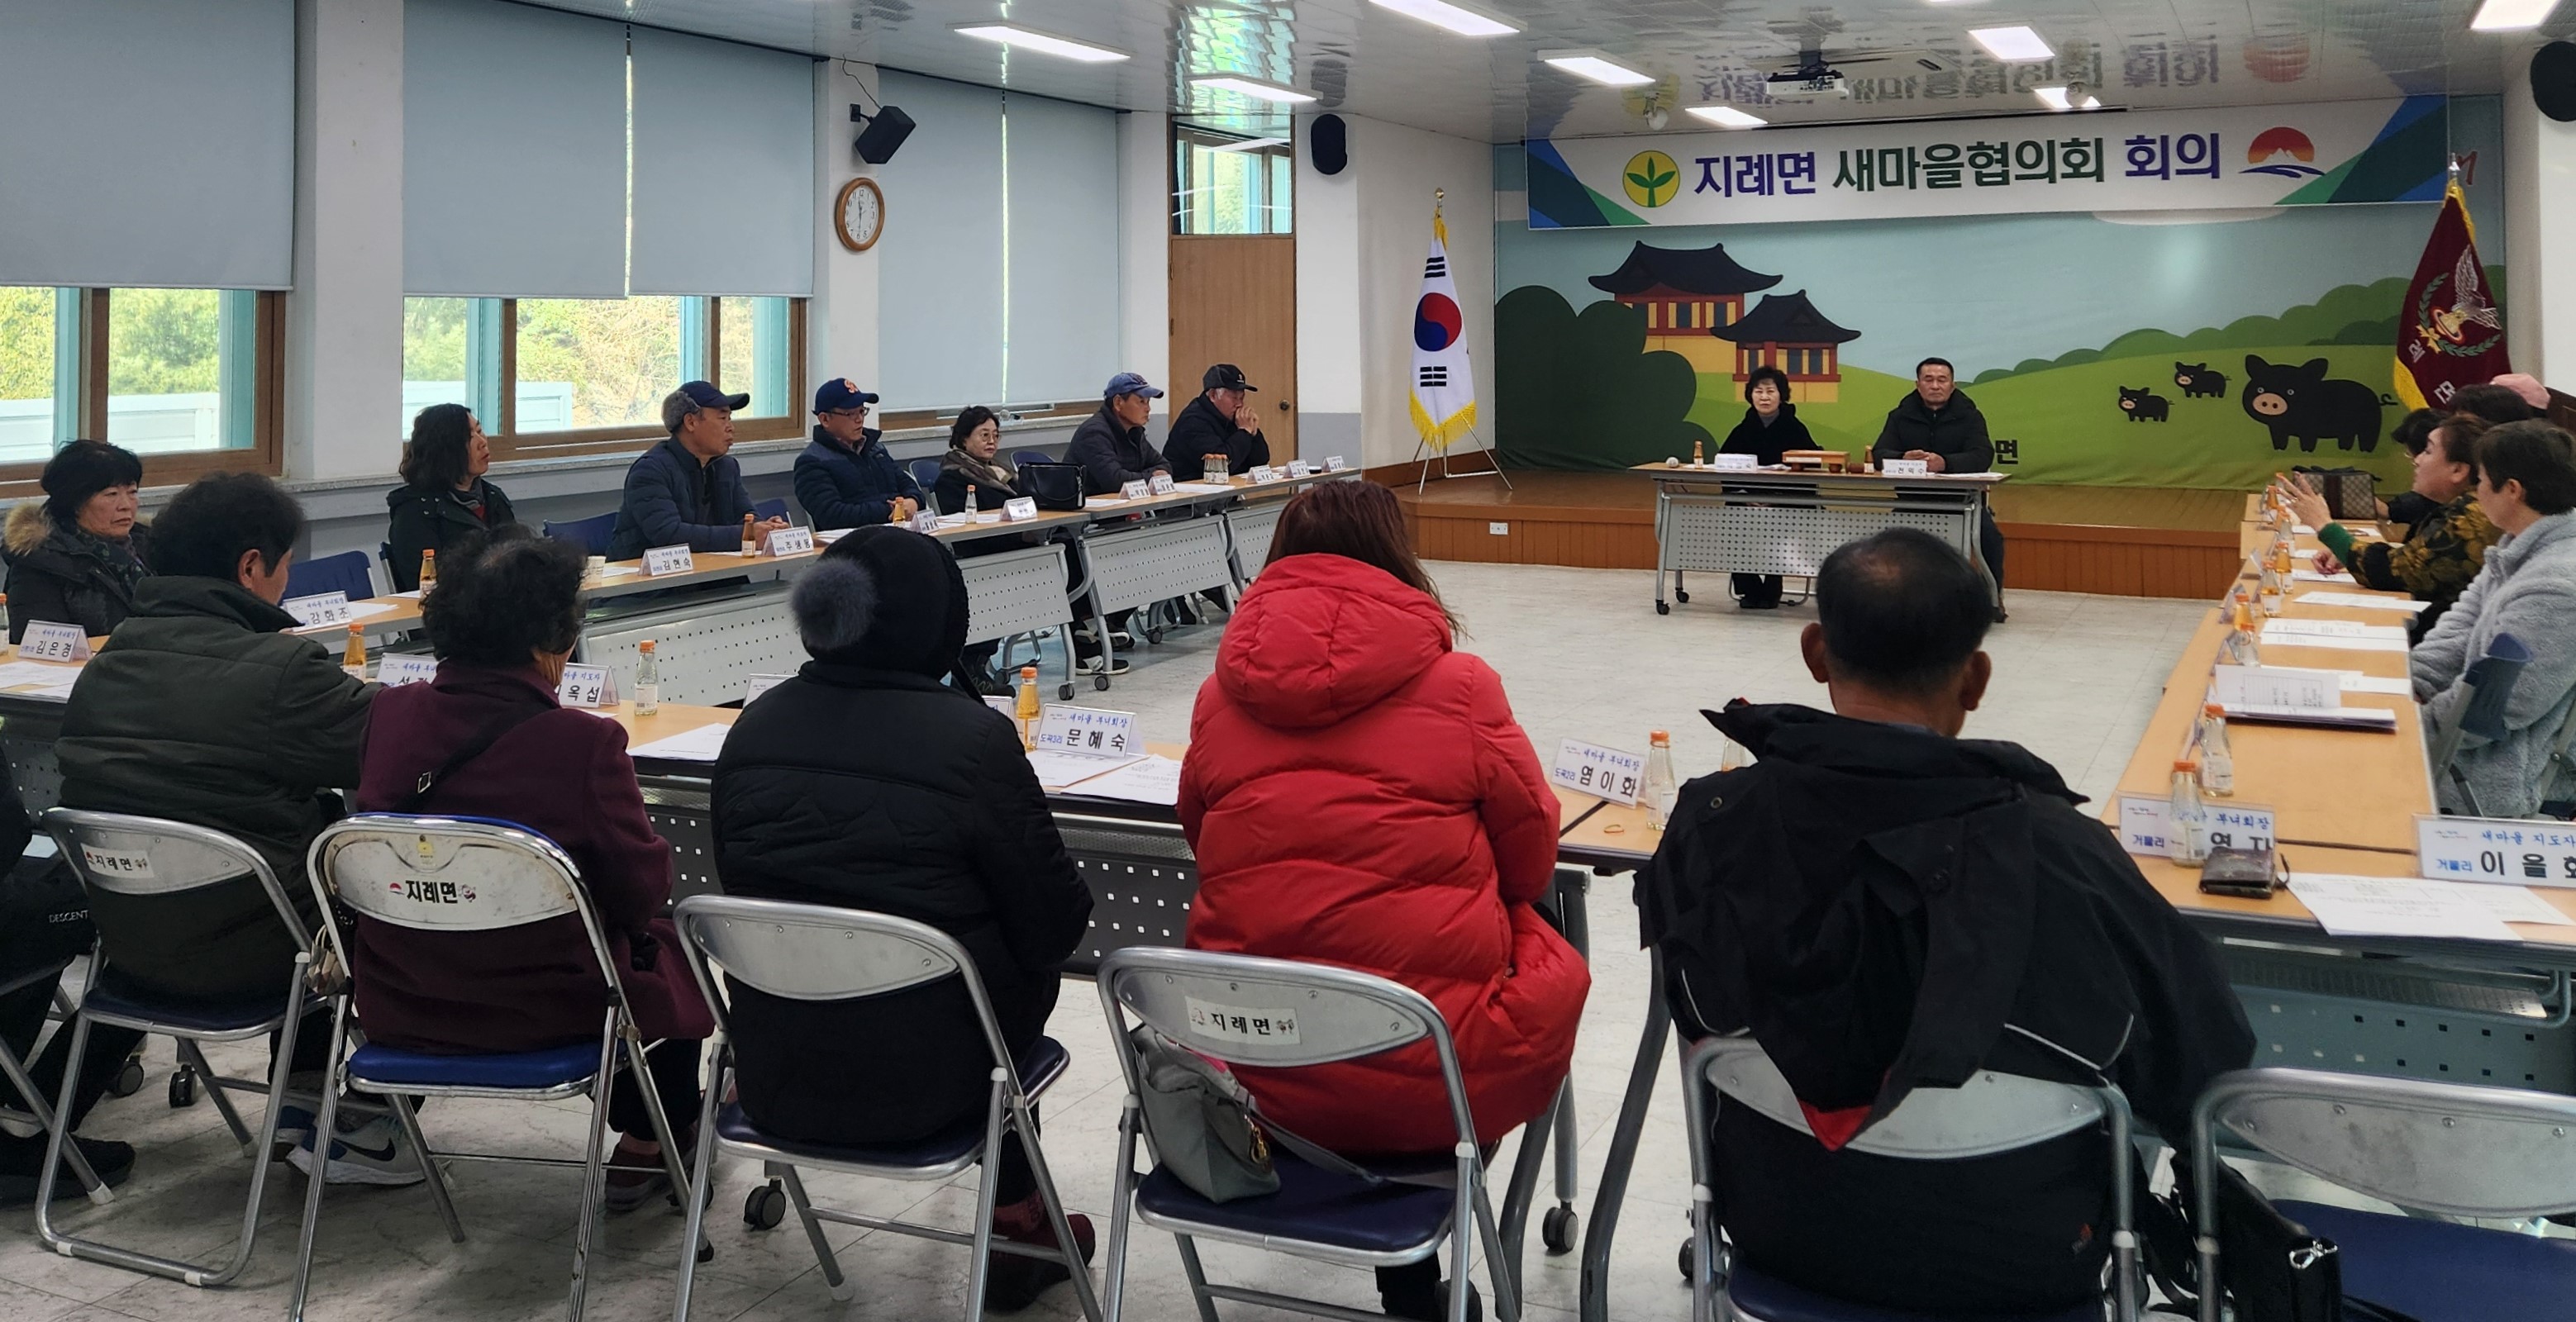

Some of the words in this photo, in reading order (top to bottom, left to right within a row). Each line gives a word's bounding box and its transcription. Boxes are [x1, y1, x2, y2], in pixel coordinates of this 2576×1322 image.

[1694, 151, 1816, 197] 지례면
[1832, 137, 2104, 192] 새마을협의회
[2125, 133, 2220, 181] 회의
[1995, 440, 2019, 465] 면
[36, 640, 72, 659] 김은경
[1066, 728, 1126, 752] 문혜숙
[1579, 765, 1637, 799] 염이화
[2216, 812, 2270, 830] 부녀회장
[2482, 830, 2524, 845] 새마을
[2532, 832, 2576, 848] 지도자
[95, 854, 133, 872] 지례면
[405, 880, 458, 904] 지례면
[1211, 1012, 1271, 1036] 지례면
